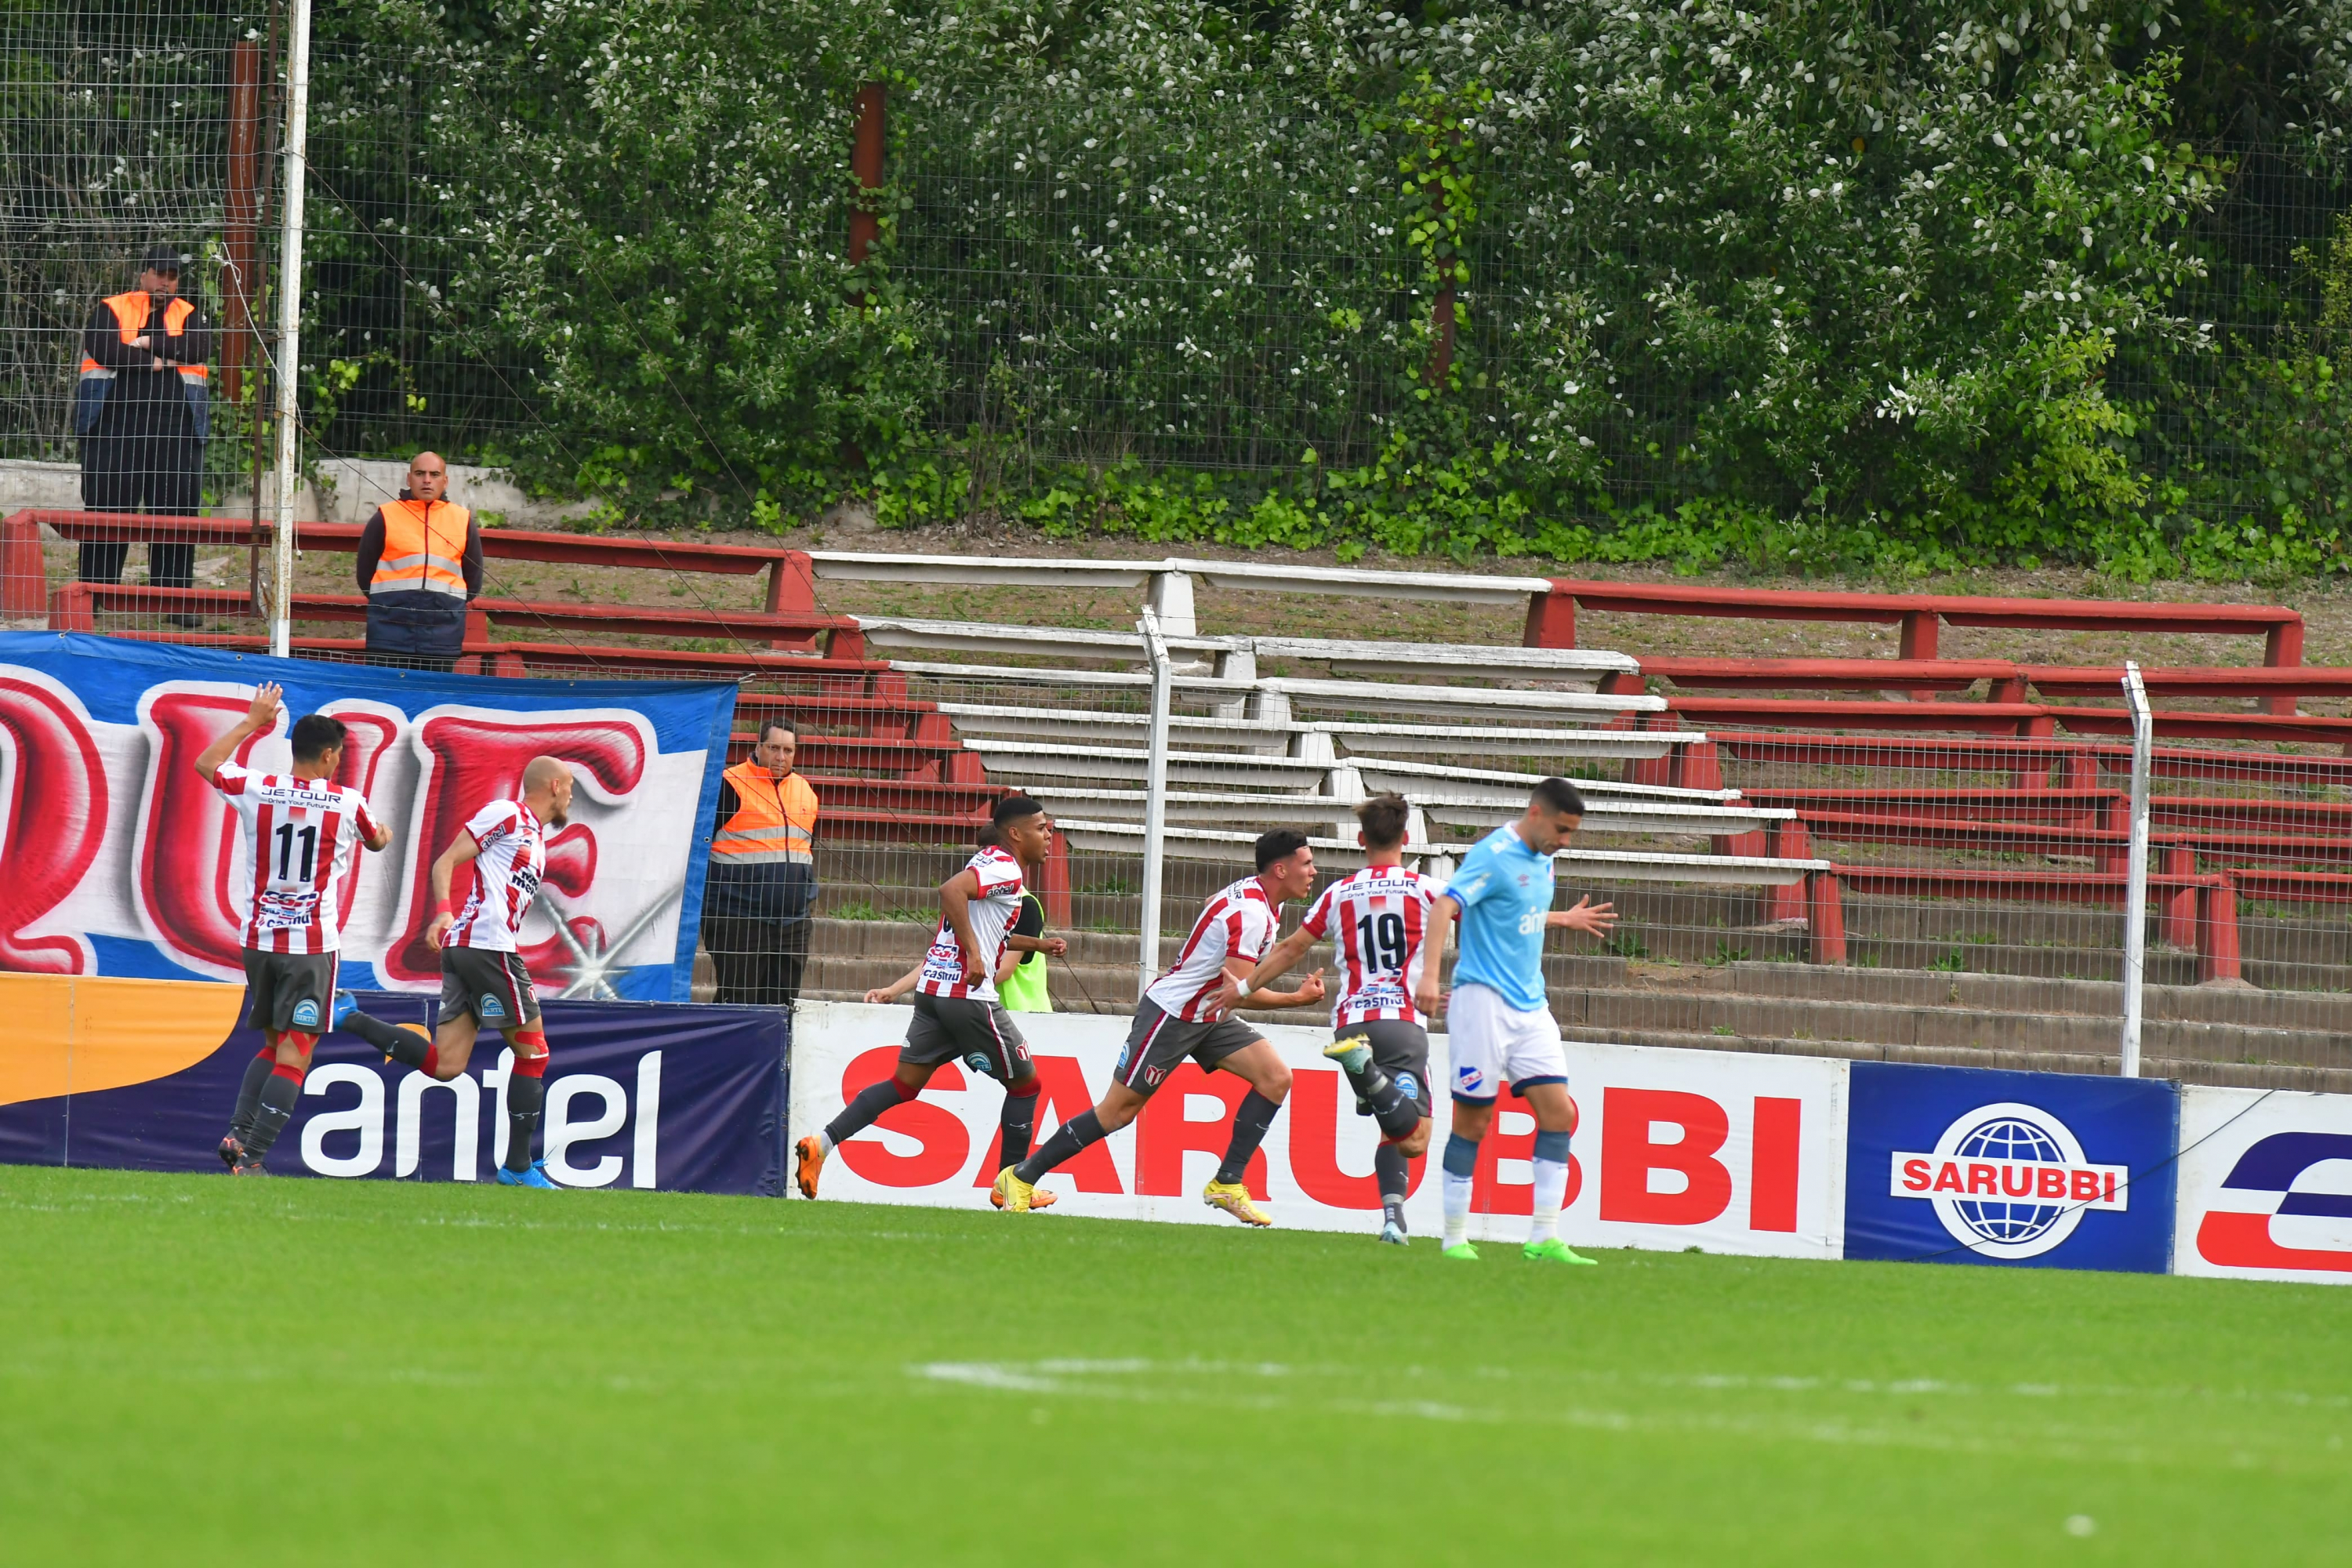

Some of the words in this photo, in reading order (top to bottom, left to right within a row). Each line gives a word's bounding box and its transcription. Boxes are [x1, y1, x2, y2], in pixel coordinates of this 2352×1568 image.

[261, 789, 341, 804] JETOUR
[481, 824, 506, 851] antel
[276, 822, 317, 882] 11
[1340, 880, 1417, 893] JETOUR
[267, 915, 310, 927] camu
[1519, 908, 1549, 935] ant
[1357, 913, 1406, 975] 19
[924, 969, 960, 981] casmu
[839, 1045, 1801, 1234] SARUBBI
[1901, 1158, 2117, 1204] SARUBBI
